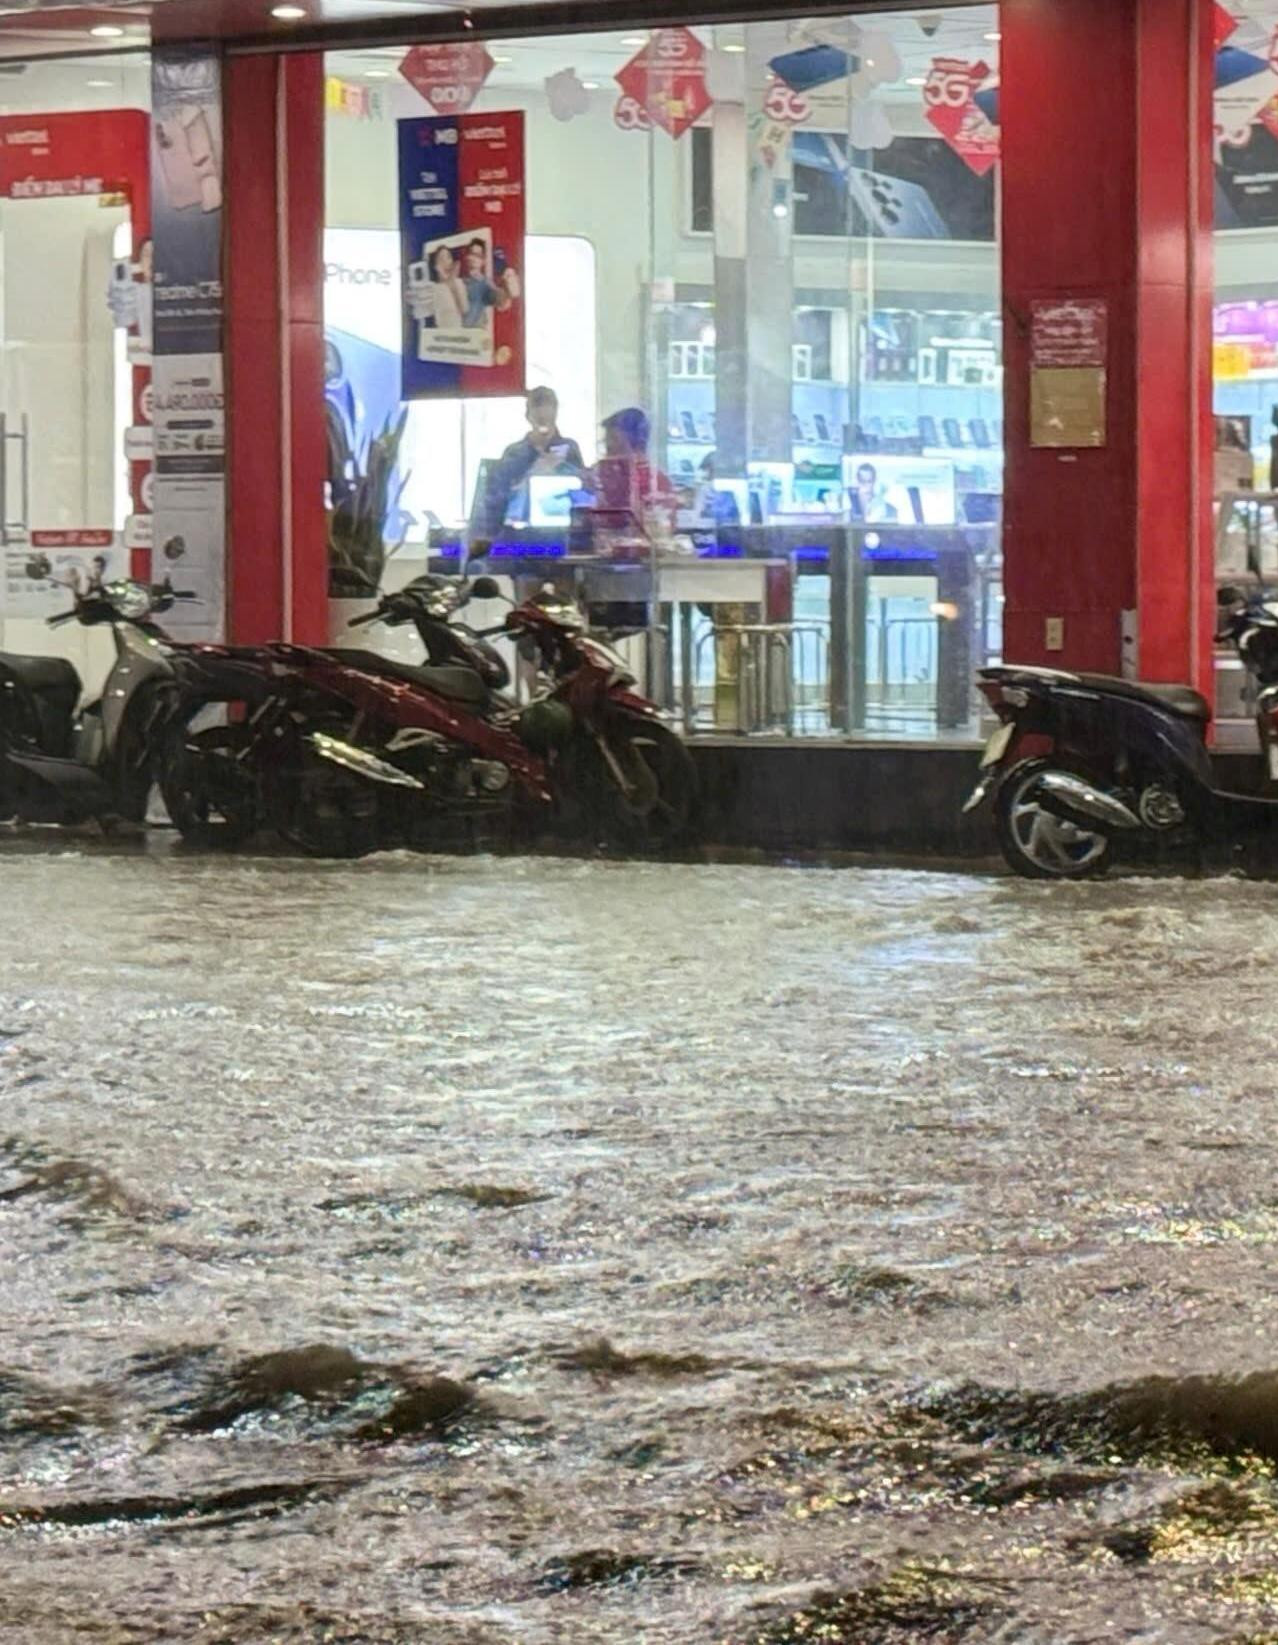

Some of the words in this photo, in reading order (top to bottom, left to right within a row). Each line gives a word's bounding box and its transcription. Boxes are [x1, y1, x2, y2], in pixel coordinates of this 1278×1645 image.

[765, 83, 812, 121] 5G
[923, 70, 970, 108] 5G
[323, 263, 392, 286] Phone
